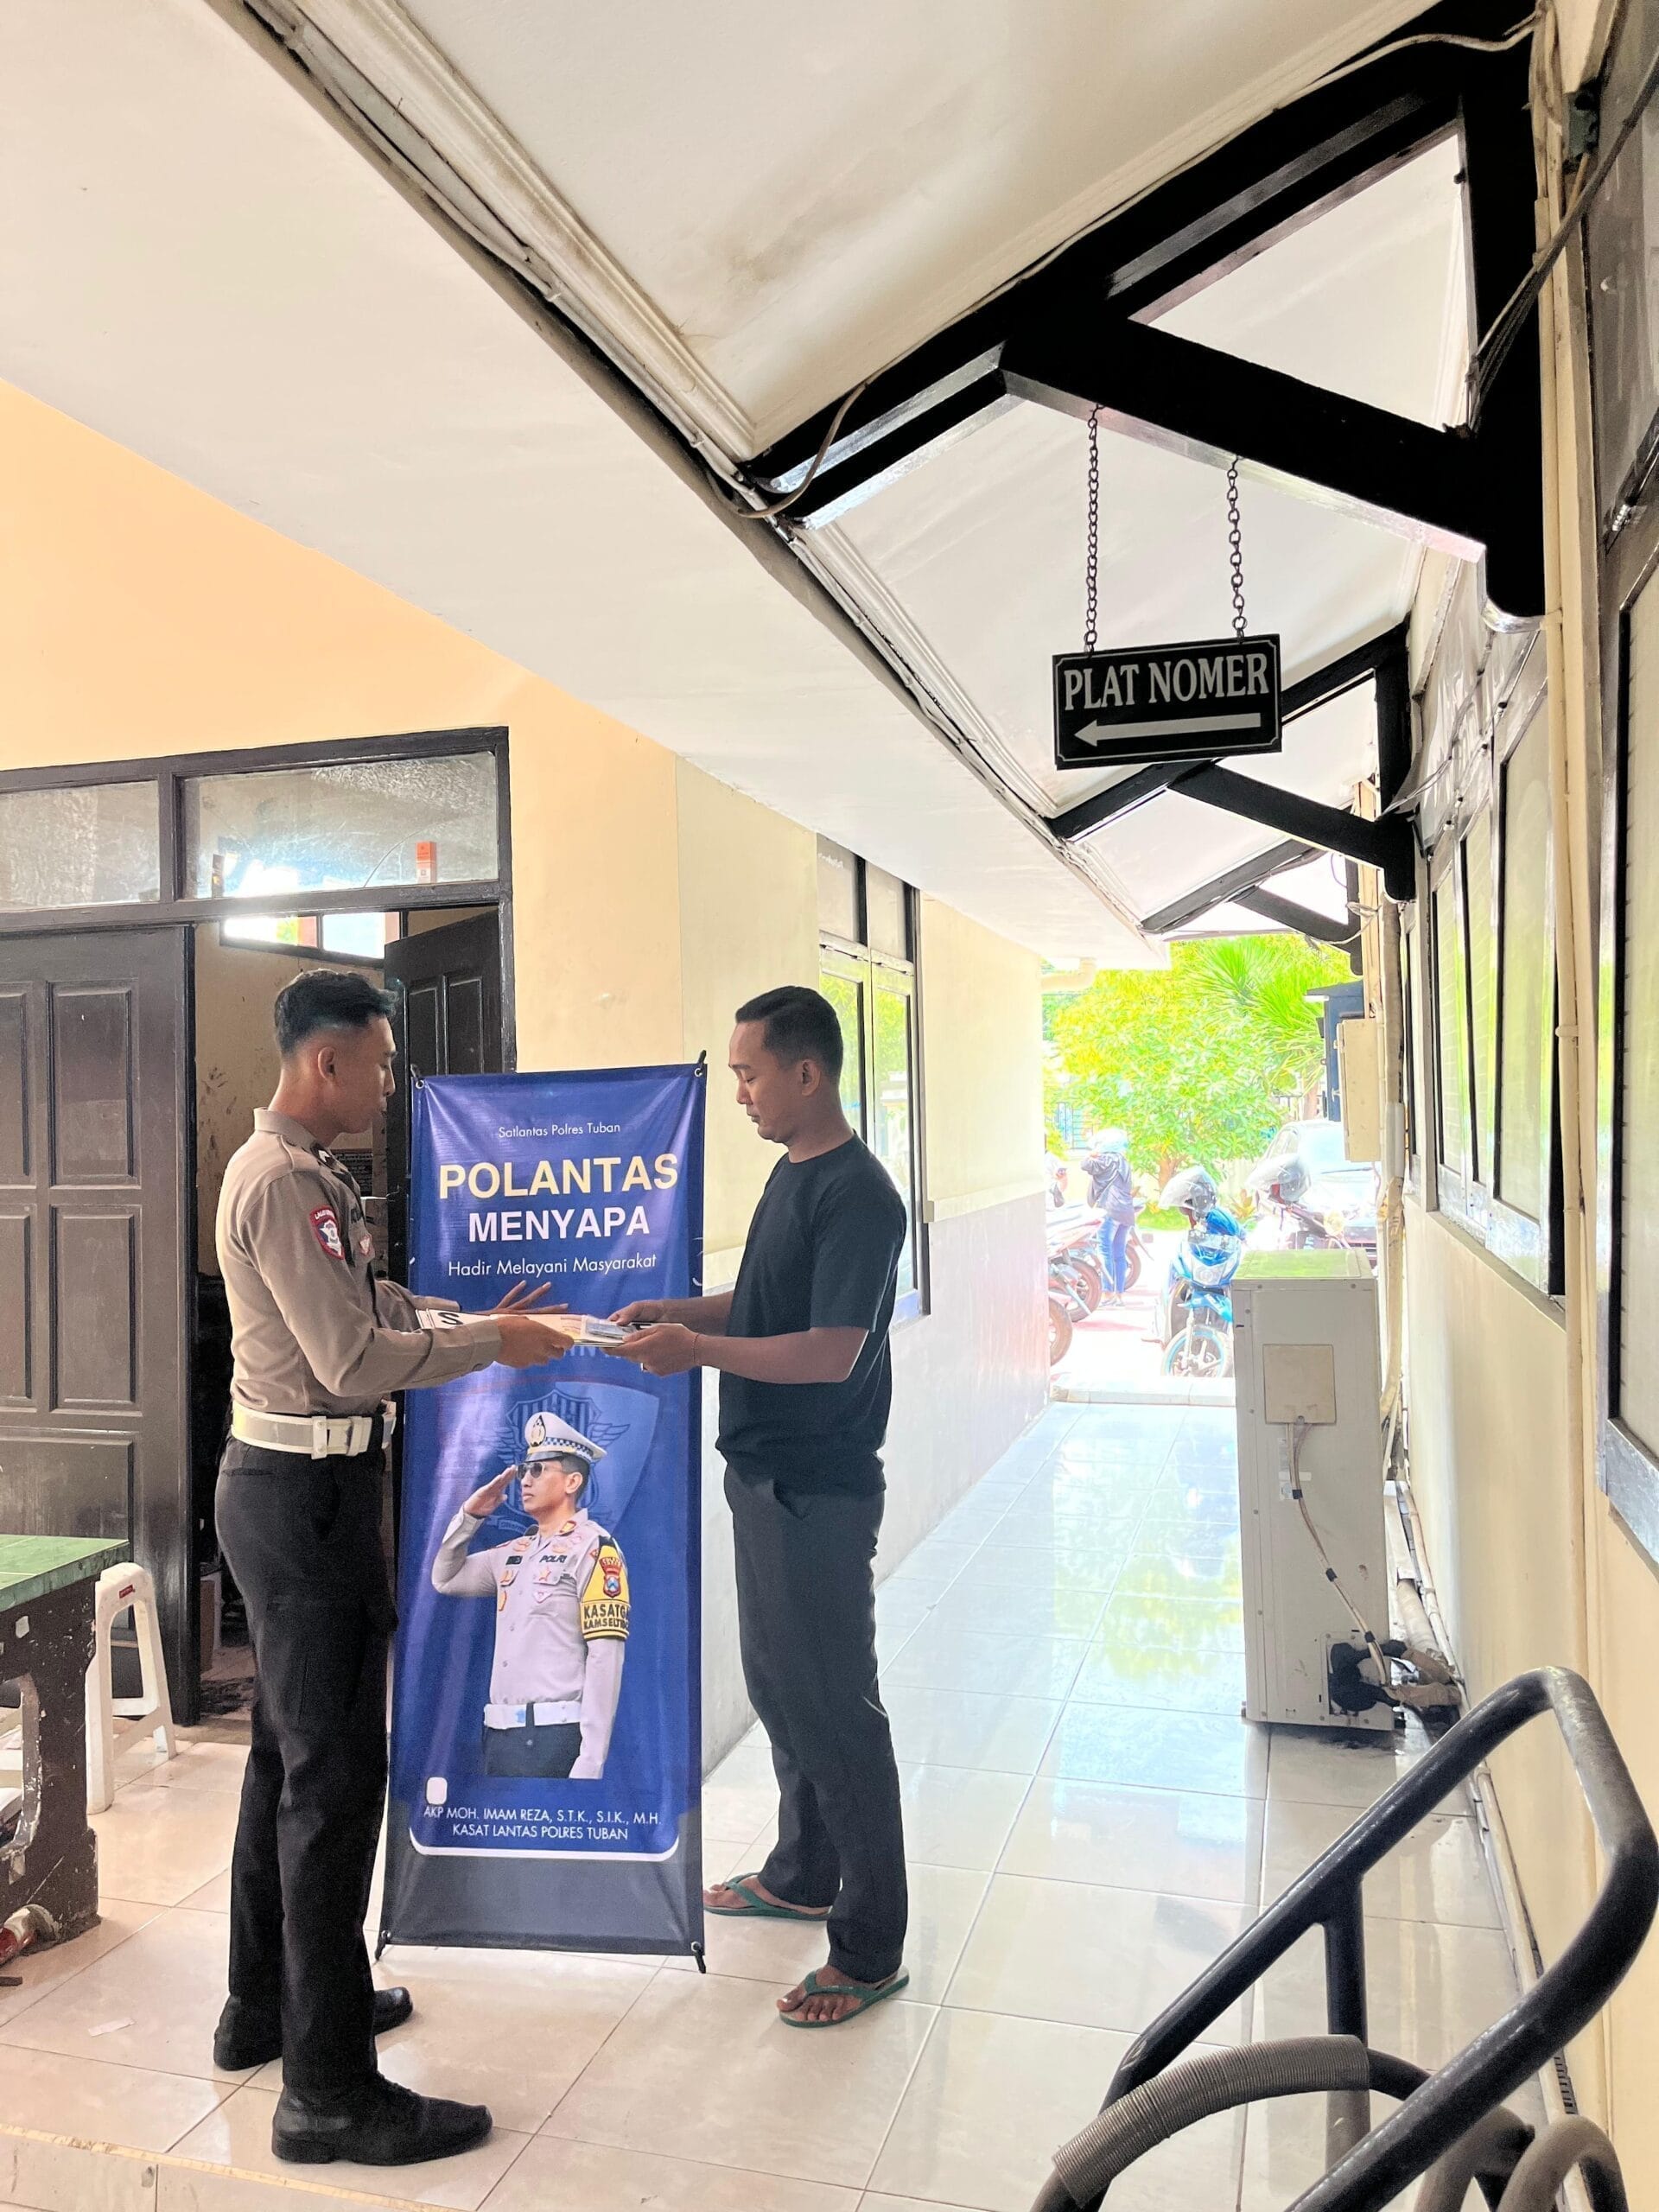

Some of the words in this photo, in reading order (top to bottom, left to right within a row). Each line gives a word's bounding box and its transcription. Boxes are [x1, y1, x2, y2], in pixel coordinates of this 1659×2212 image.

[1064, 664, 1139, 711] PLAT
[1148, 653, 1269, 703] NOMER
[499, 1125, 548, 1138] Satlantas
[551, 1122, 583, 1135] Polres
[587, 1122, 620, 1134] Tuban
[439, 1153, 678, 1199] POLANTAS
[468, 1205, 650, 1243] MENYAPA
[448, 1261, 492, 1276] Hadir
[496, 1257, 567, 1278] Melayani
[572, 1253, 657, 1275] Masyarakat
[423, 1806, 443, 1818] AKP
[447, 1807, 480, 1820] MOH.
[483, 1808, 517, 1821] IMAM
[520, 1808, 553, 1823] REZA,
[556, 1809, 593, 1824] S.T.K.,
[596, 1810, 629, 1825] S.I.K.,
[633, 1812, 662, 1825] M.H.
[453, 1824, 489, 1836] KASAT
[493, 1825, 537, 1838] LANTAS
[541, 1826, 583, 1840] POLRES
[587, 1827, 628, 1840] TUBAN
